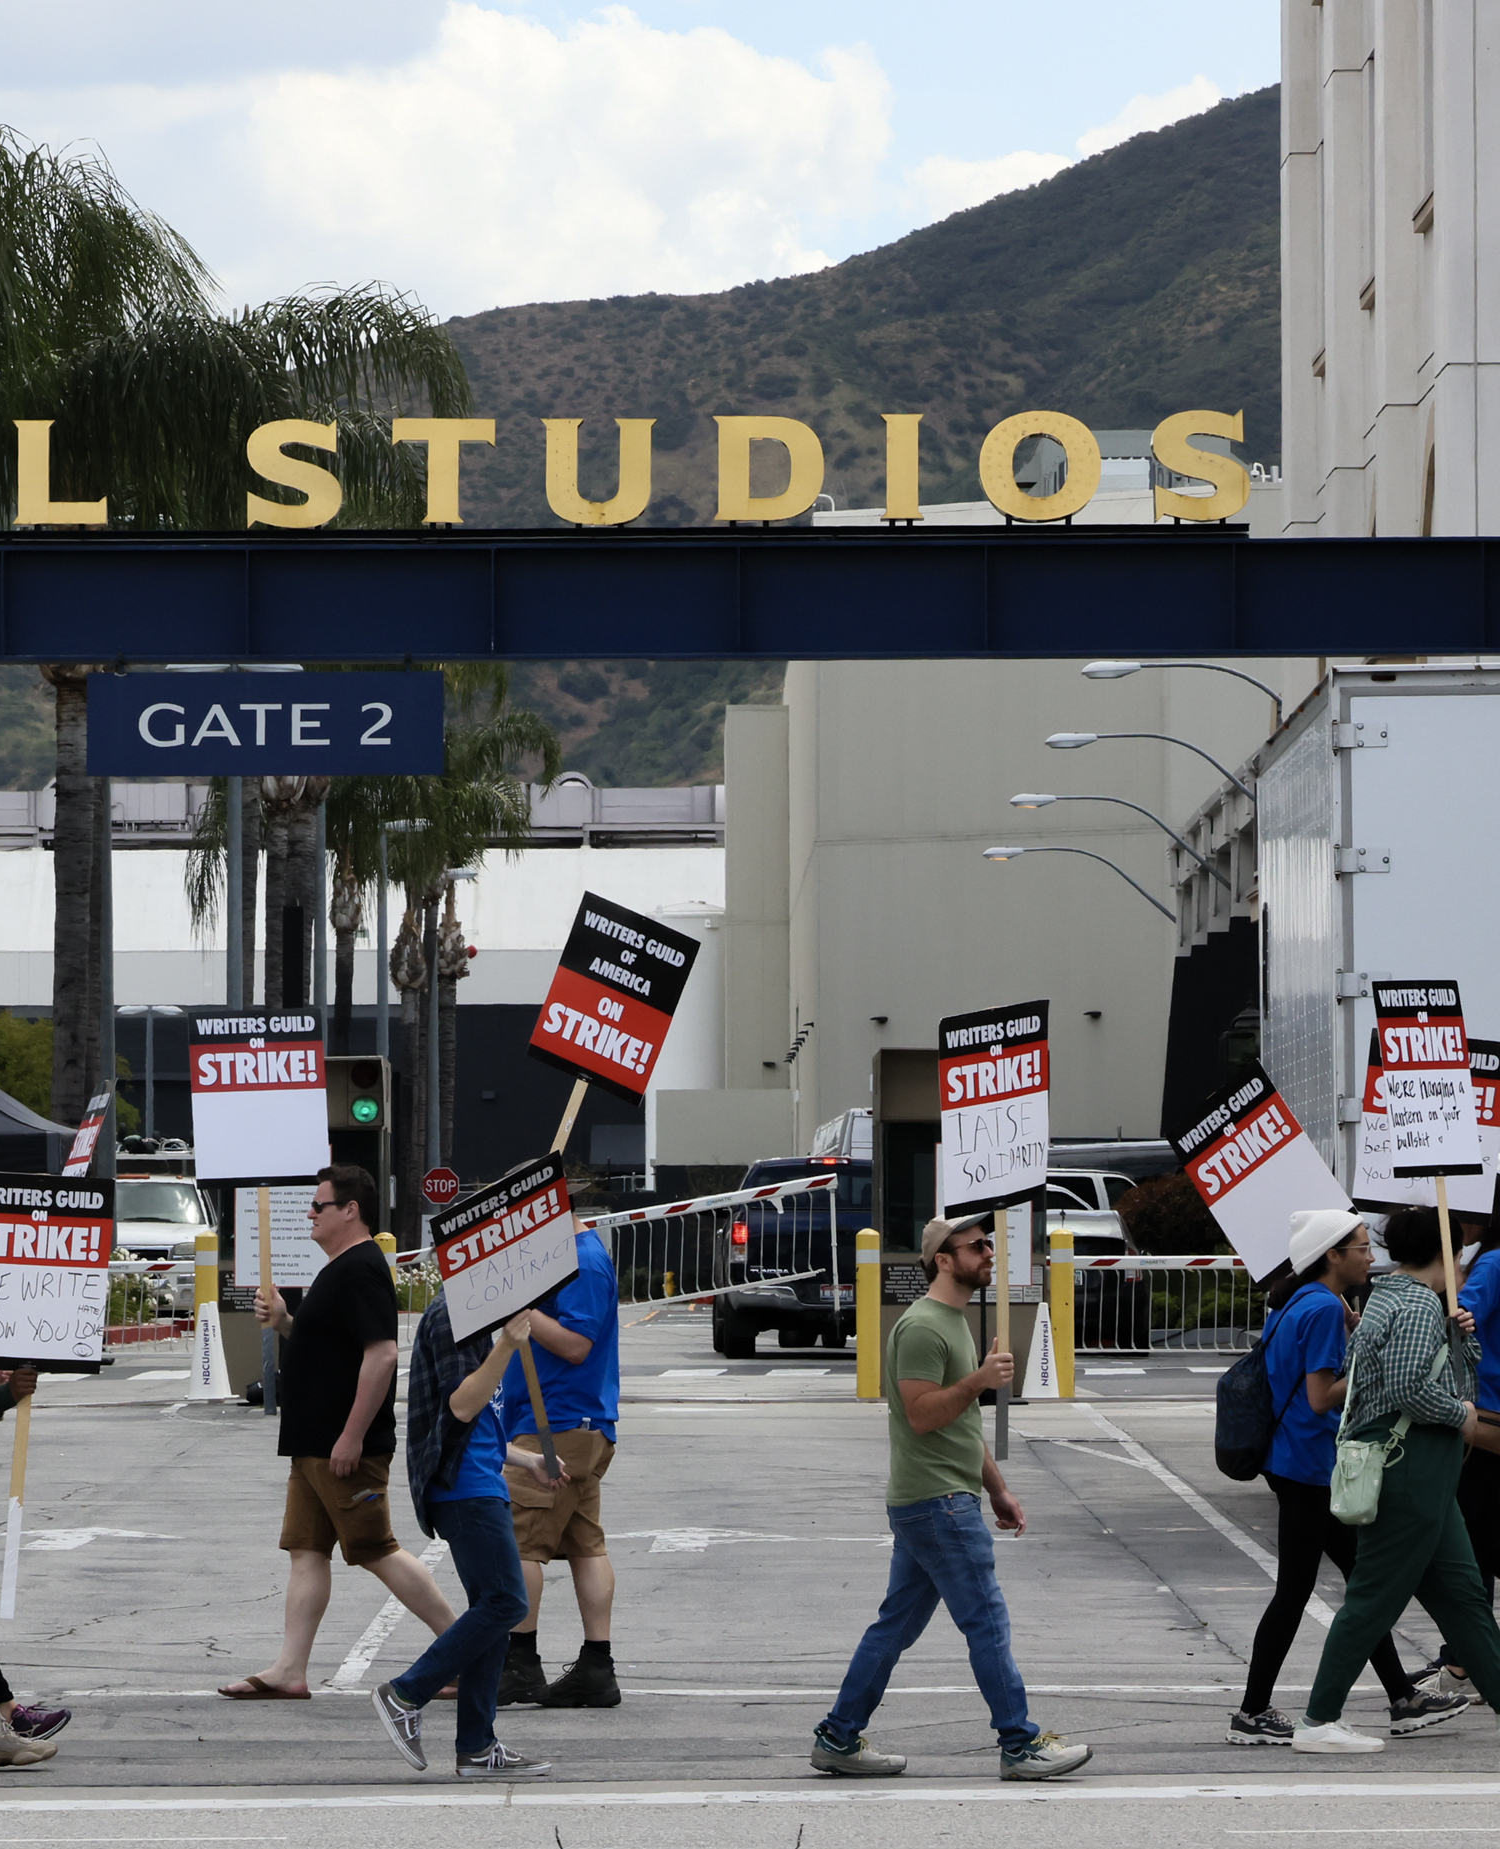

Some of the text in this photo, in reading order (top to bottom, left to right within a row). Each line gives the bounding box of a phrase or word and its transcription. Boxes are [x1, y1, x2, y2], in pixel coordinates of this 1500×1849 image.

[246, 409, 1251, 529] STUDIOS
[138, 702, 393, 748] GATE 2
[584, 909, 686, 968] WRITERS GUILD
[620, 950, 637, 966] OF
[588, 957, 651, 997] AMERICA
[597, 997, 625, 1023] ON
[1378, 988, 1457, 1008] WRITERS GUILD
[196, 1015, 315, 1035] WRITERS GUILD
[946, 1015, 1041, 1049] WRITERS GUILD
[1417, 1011, 1428, 1023] ON
[249, 1038, 265, 1049] ON
[542, 1002, 654, 1075] STRIKE!
[989, 1044, 1003, 1057] ON
[1384, 1026, 1465, 1063] STRIKE!
[198, 1050, 318, 1086] STRIKE!
[947, 1049, 1042, 1103] STRIKE!
[1468, 1051, 1500, 1071] UILD
[1419, 1077, 1457, 1110] hanging
[1459, 1081, 1465, 1094] a
[948, 1102, 1033, 1157] IATSE
[1177, 1077, 1264, 1154] WRITERS GUILD
[1223, 1122, 1237, 1137] ON
[1390, 1104, 1461, 1130] lantern on your
[1197, 1104, 1292, 1196] STRIKE!
[1396, 1131, 1430, 1150] bullshit
[55, 1190, 104, 1210] GUILD
[425, 1179, 457, 1193] STOP
[440, 1191, 508, 1235] WRITERS
[510, 1166, 554, 1198] GUILD
[31, 1210, 48, 1222] ON
[446, 1188, 561, 1271] STRIKE!
[493, 1206, 508, 1220] ON
[466, 1235, 575, 1311] CONTRACT
[468, 1239, 532, 1289] FAIR
[21, 1271, 101, 1301] WRITE
[27, 1316, 69, 1342] YOU
[75, 1319, 104, 1339] LOVE
[201, 1319, 210, 1385] NBCUniversal
[1041, 1321, 1049, 1387] NBCUniversal
